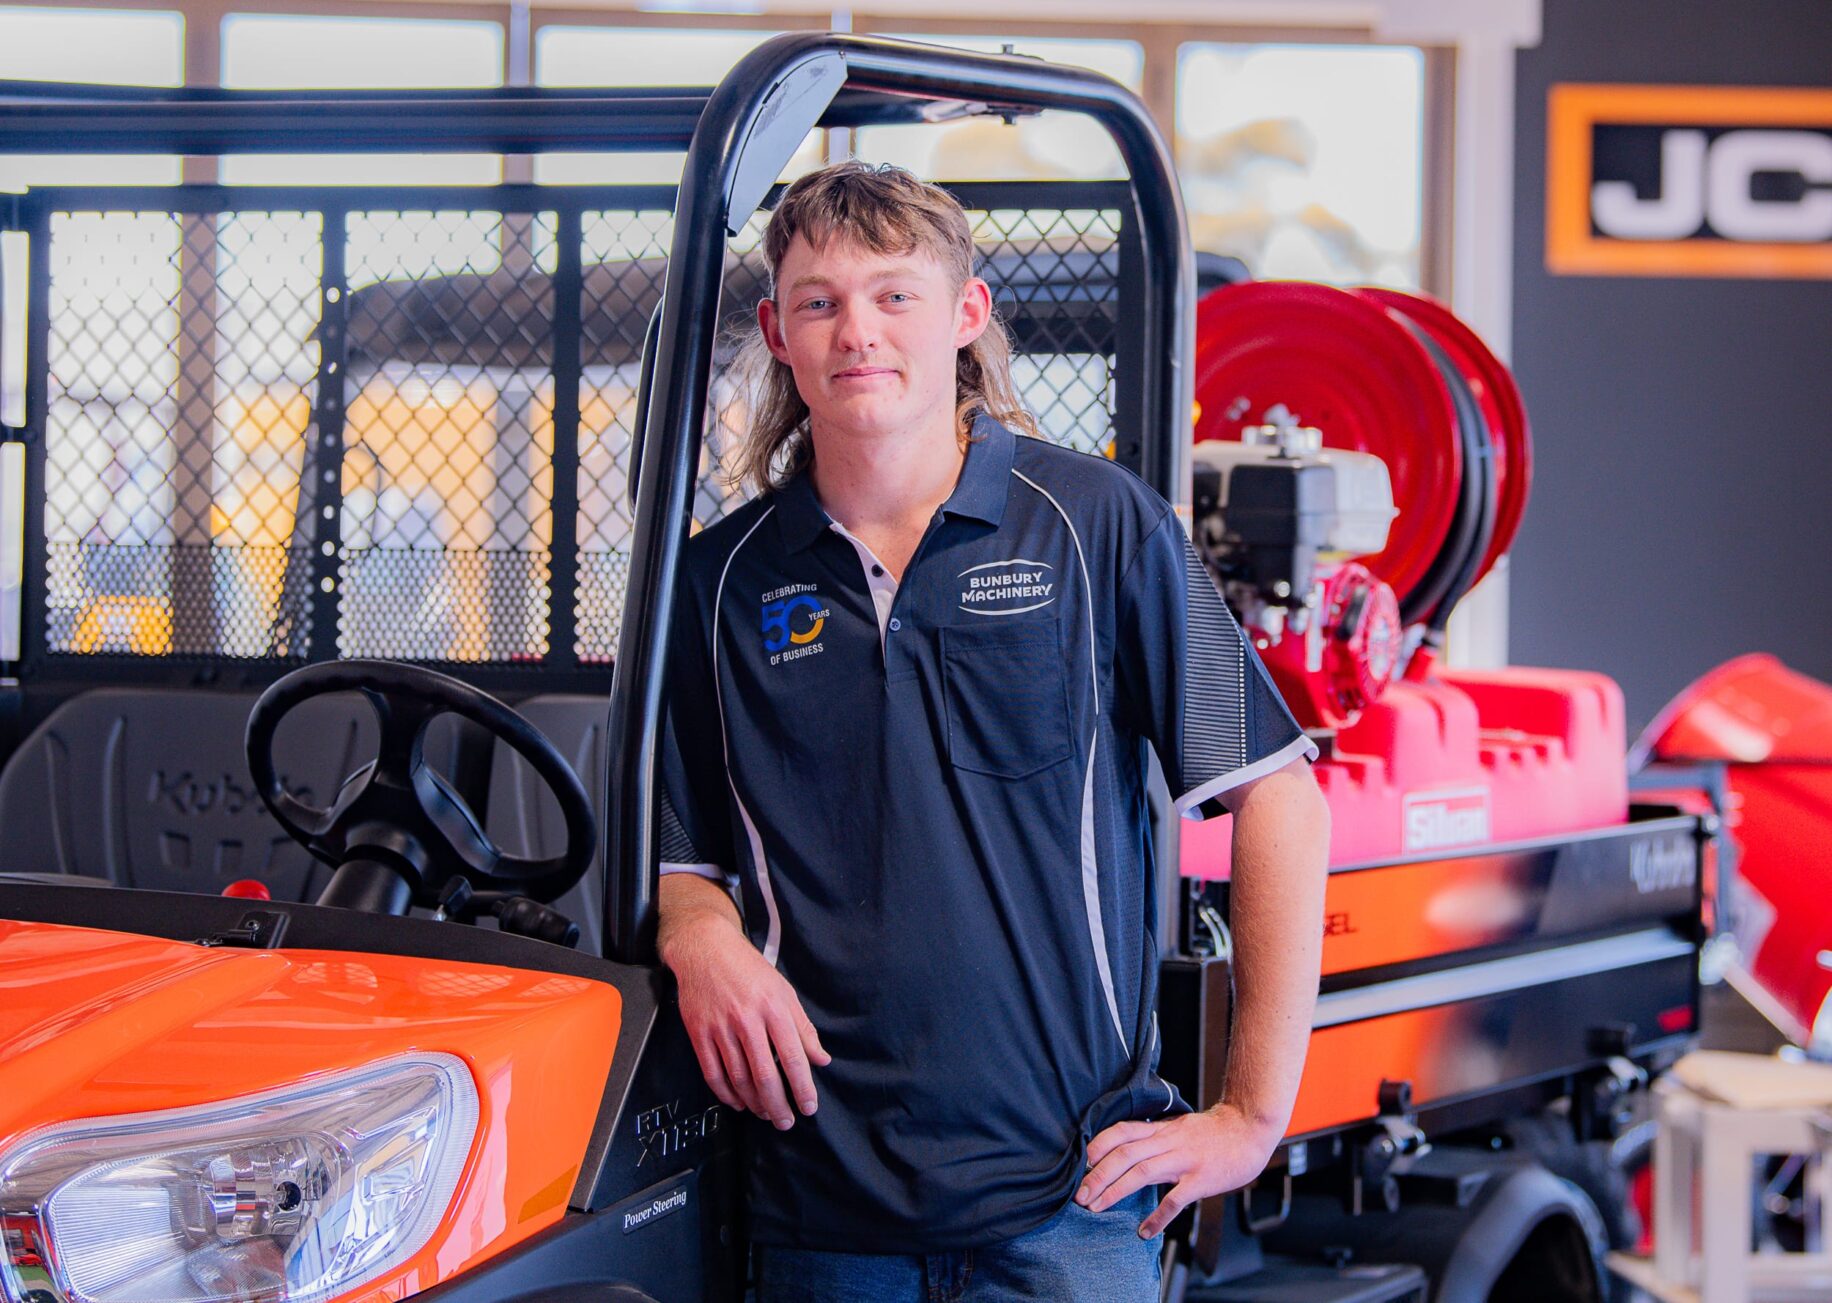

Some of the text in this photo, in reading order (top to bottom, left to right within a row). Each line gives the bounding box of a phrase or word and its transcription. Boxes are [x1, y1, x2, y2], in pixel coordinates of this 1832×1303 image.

[1590, 127, 1832, 243] JC
[761, 583, 818, 603] CELEBRATING
[961, 583, 1054, 603] MACHINERY
[970, 571, 1043, 589] BUNBURY
[761, 595, 831, 652] 50 YEARS
[770, 642, 824, 666] OF BUSINESS
[637, 1099, 679, 1134] RTV
[624, 1191, 687, 1228] Power Steering
